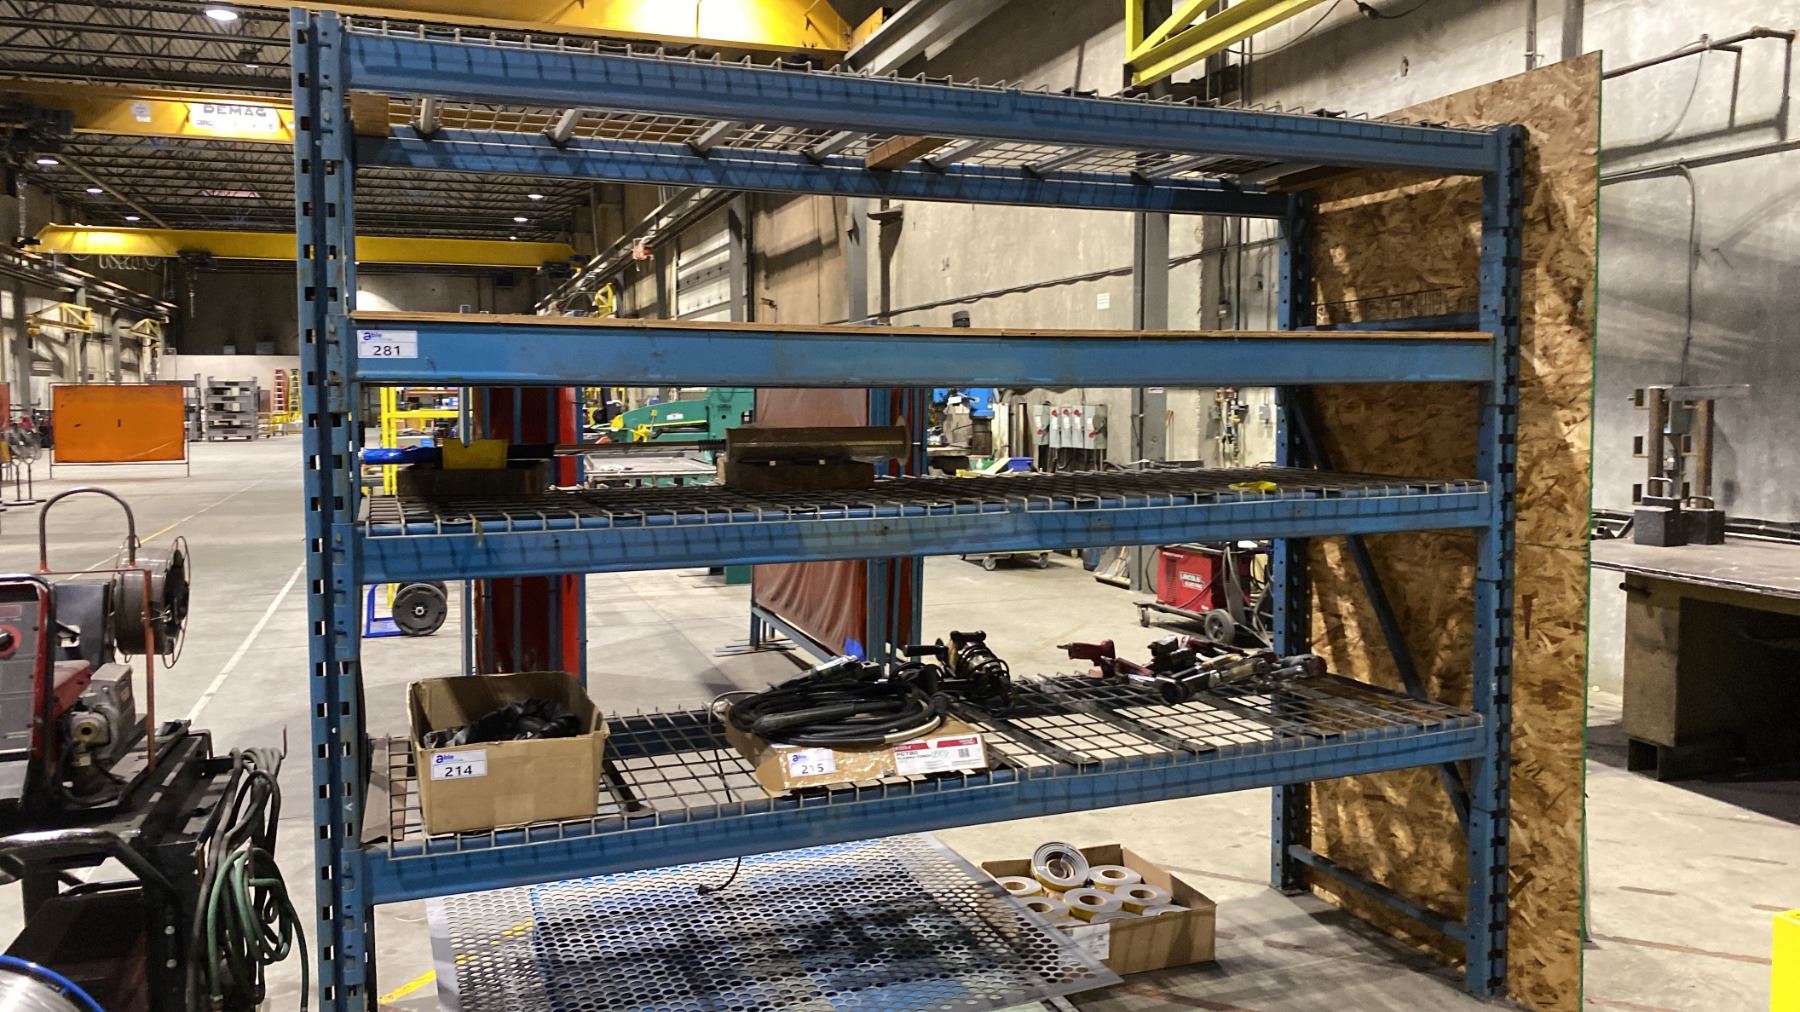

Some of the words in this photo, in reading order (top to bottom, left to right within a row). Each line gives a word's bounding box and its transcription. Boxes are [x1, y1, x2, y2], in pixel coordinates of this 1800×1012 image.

[203, 104, 266, 117] DEMAG
[373, 345, 400, 356] 281
[445, 765, 472, 777] 214
[801, 763, 824, 774] 215
